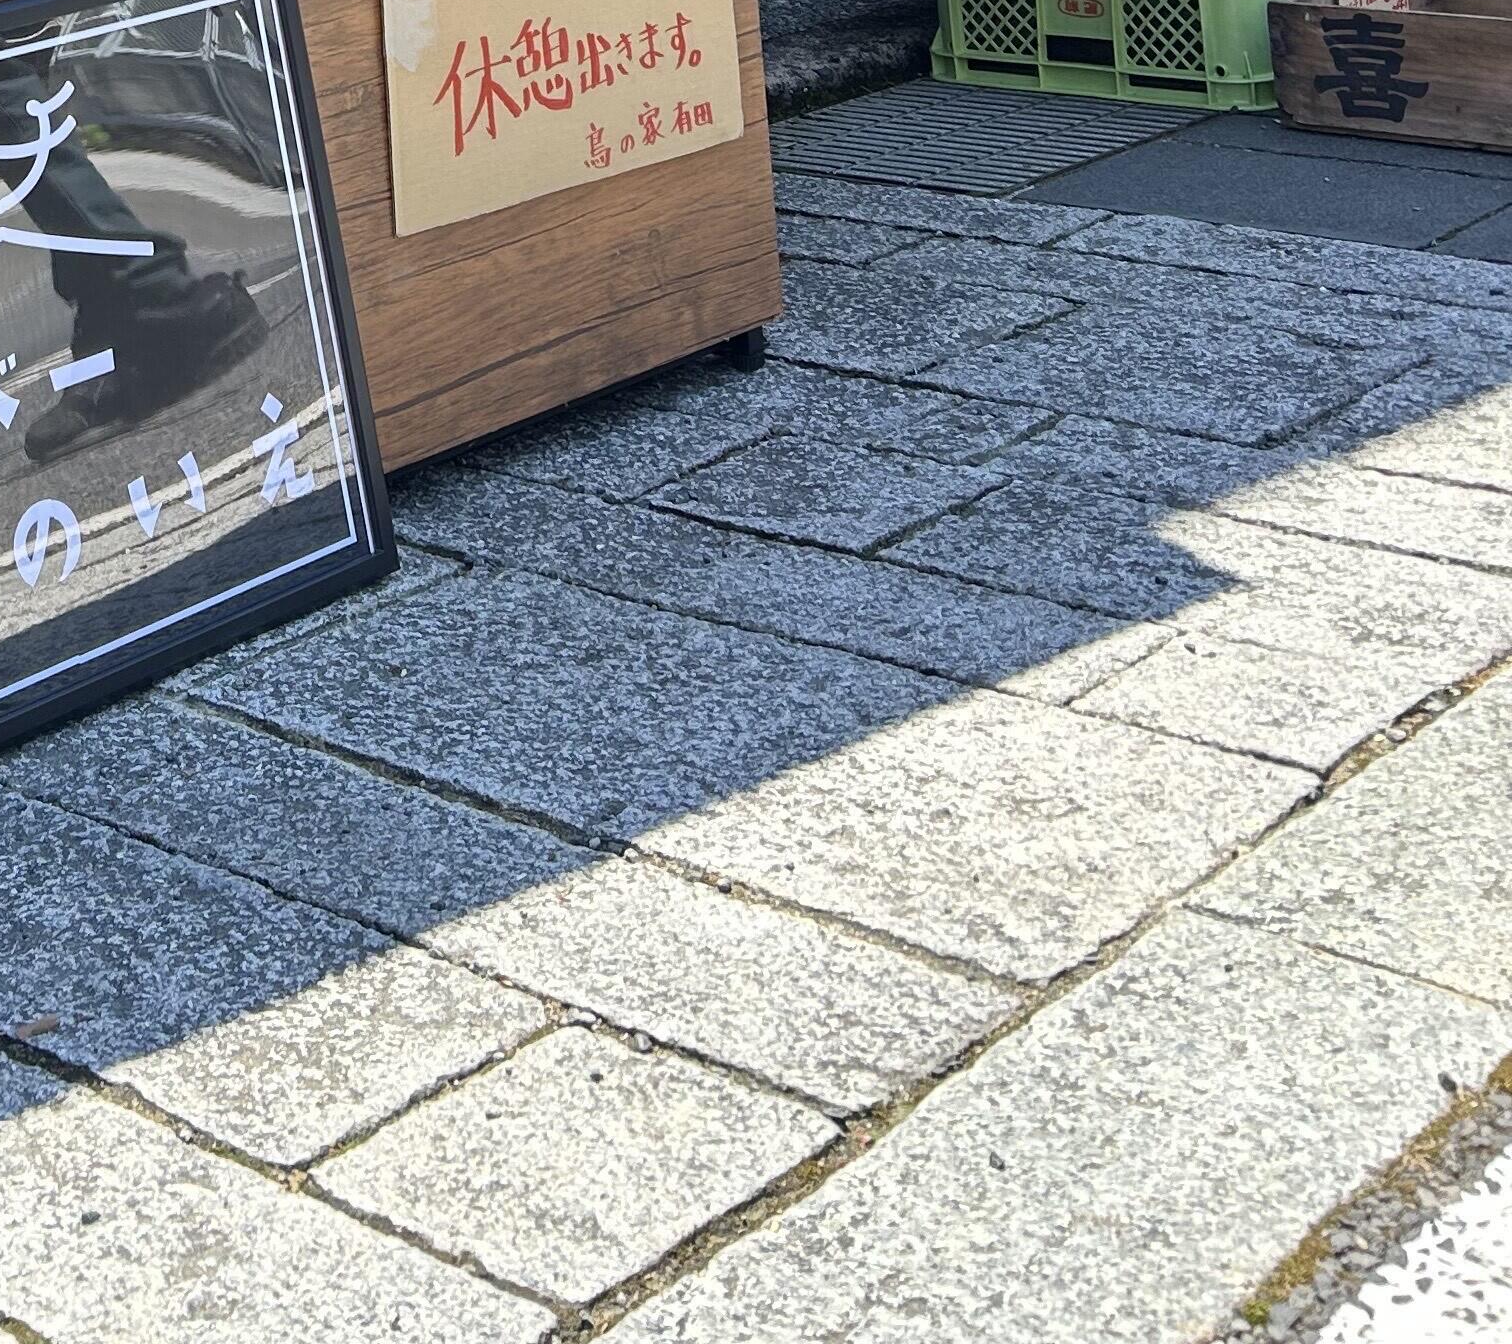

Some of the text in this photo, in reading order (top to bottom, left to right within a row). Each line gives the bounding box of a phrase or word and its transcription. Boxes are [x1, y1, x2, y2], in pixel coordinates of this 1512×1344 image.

[433, 12, 701, 157] 休憩出きます。
[1314, 13, 1430, 122] 喜
